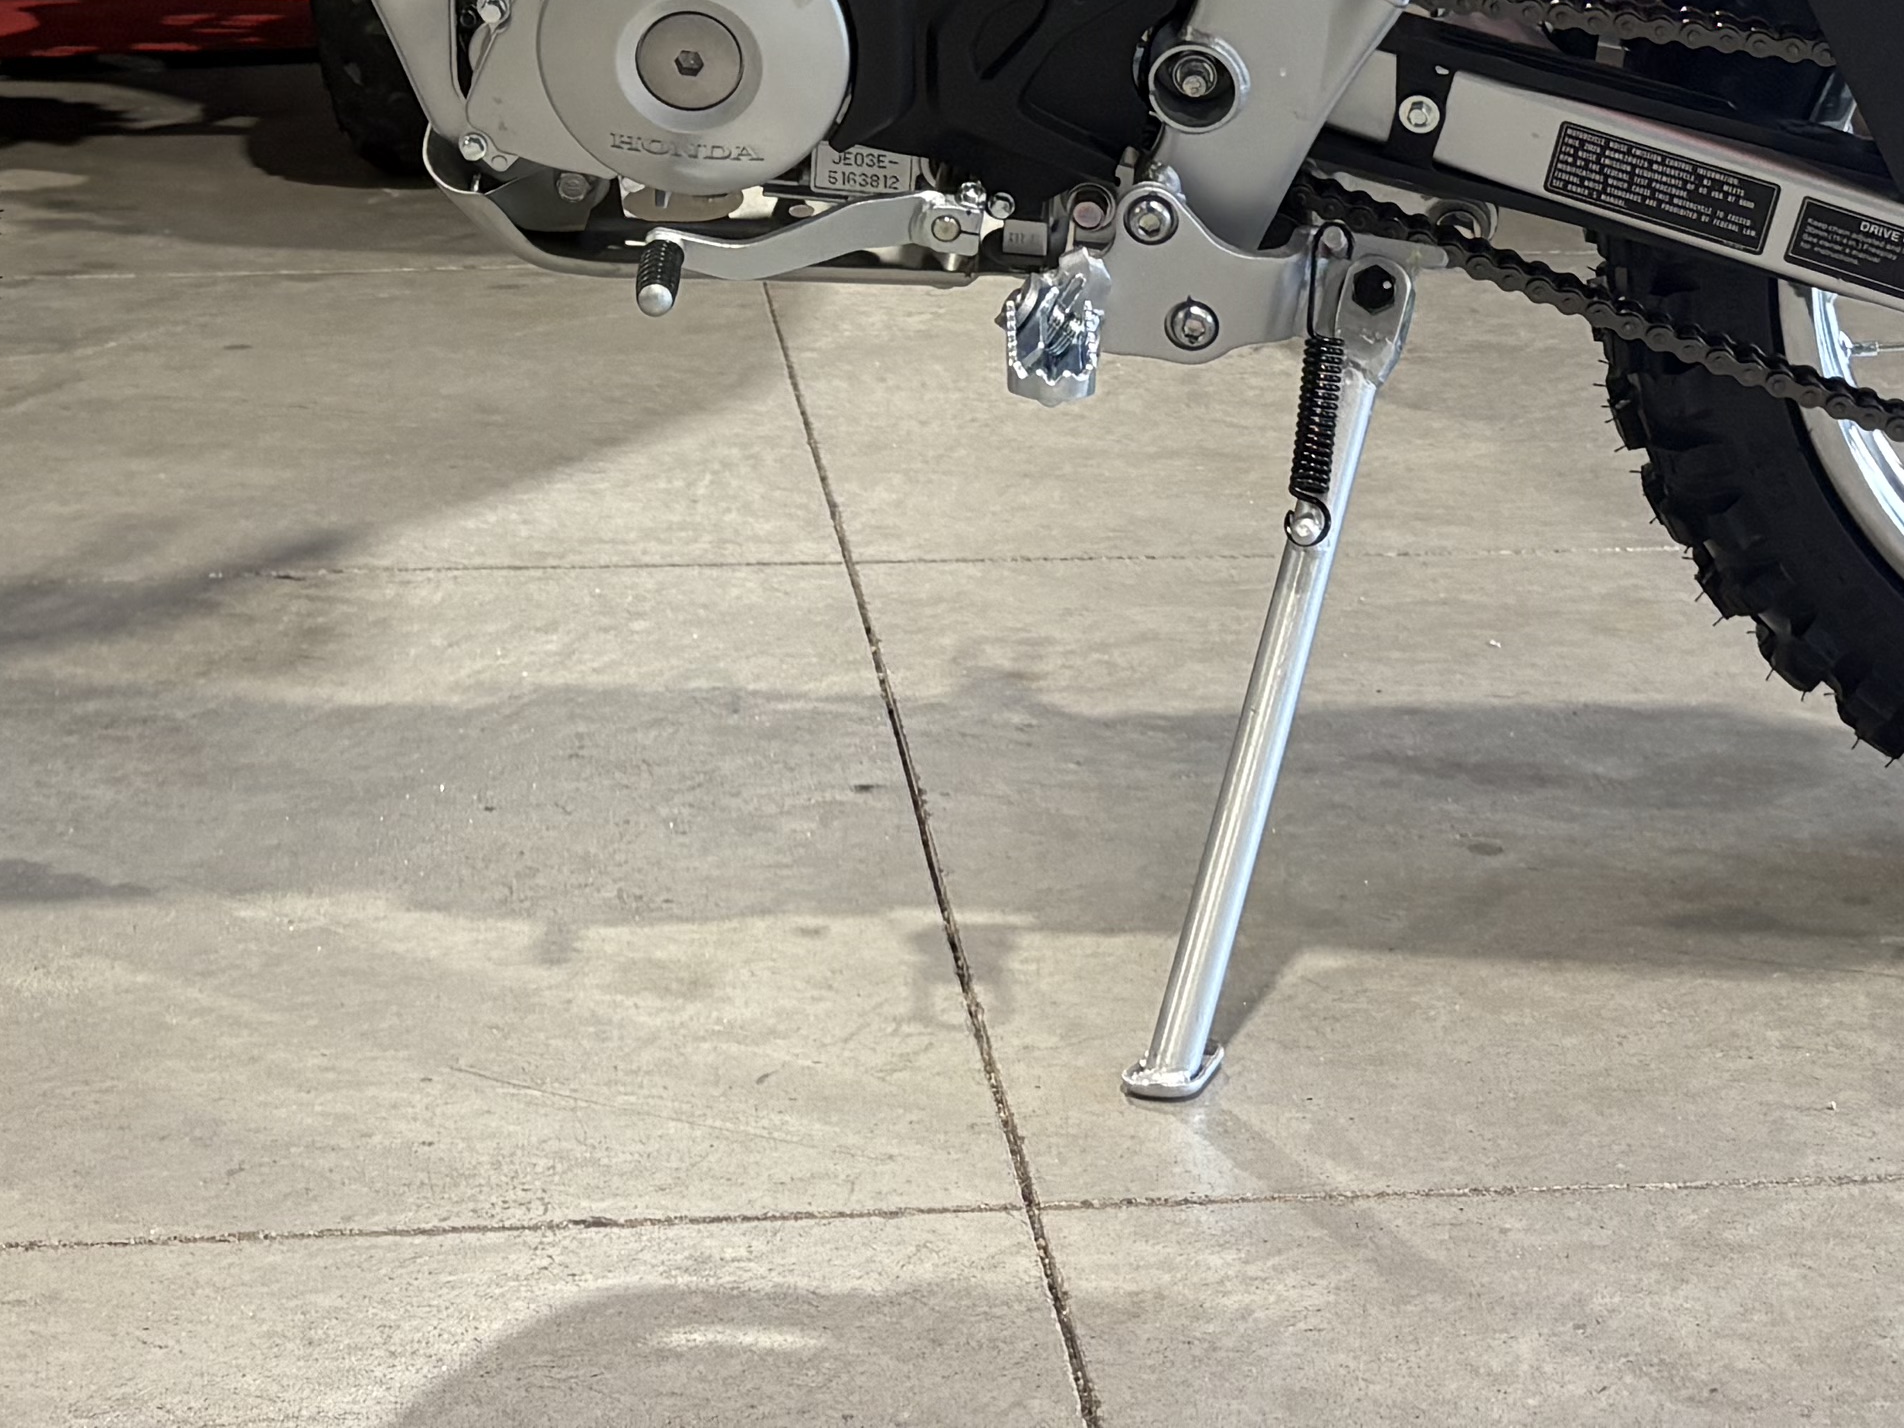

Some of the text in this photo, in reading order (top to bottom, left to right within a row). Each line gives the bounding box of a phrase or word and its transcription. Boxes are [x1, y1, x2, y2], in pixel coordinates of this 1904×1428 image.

[609, 131, 766, 162] HONDA
[827, 170, 901, 190] 5163812
[1858, 219, 1902, 243] DRIVE
